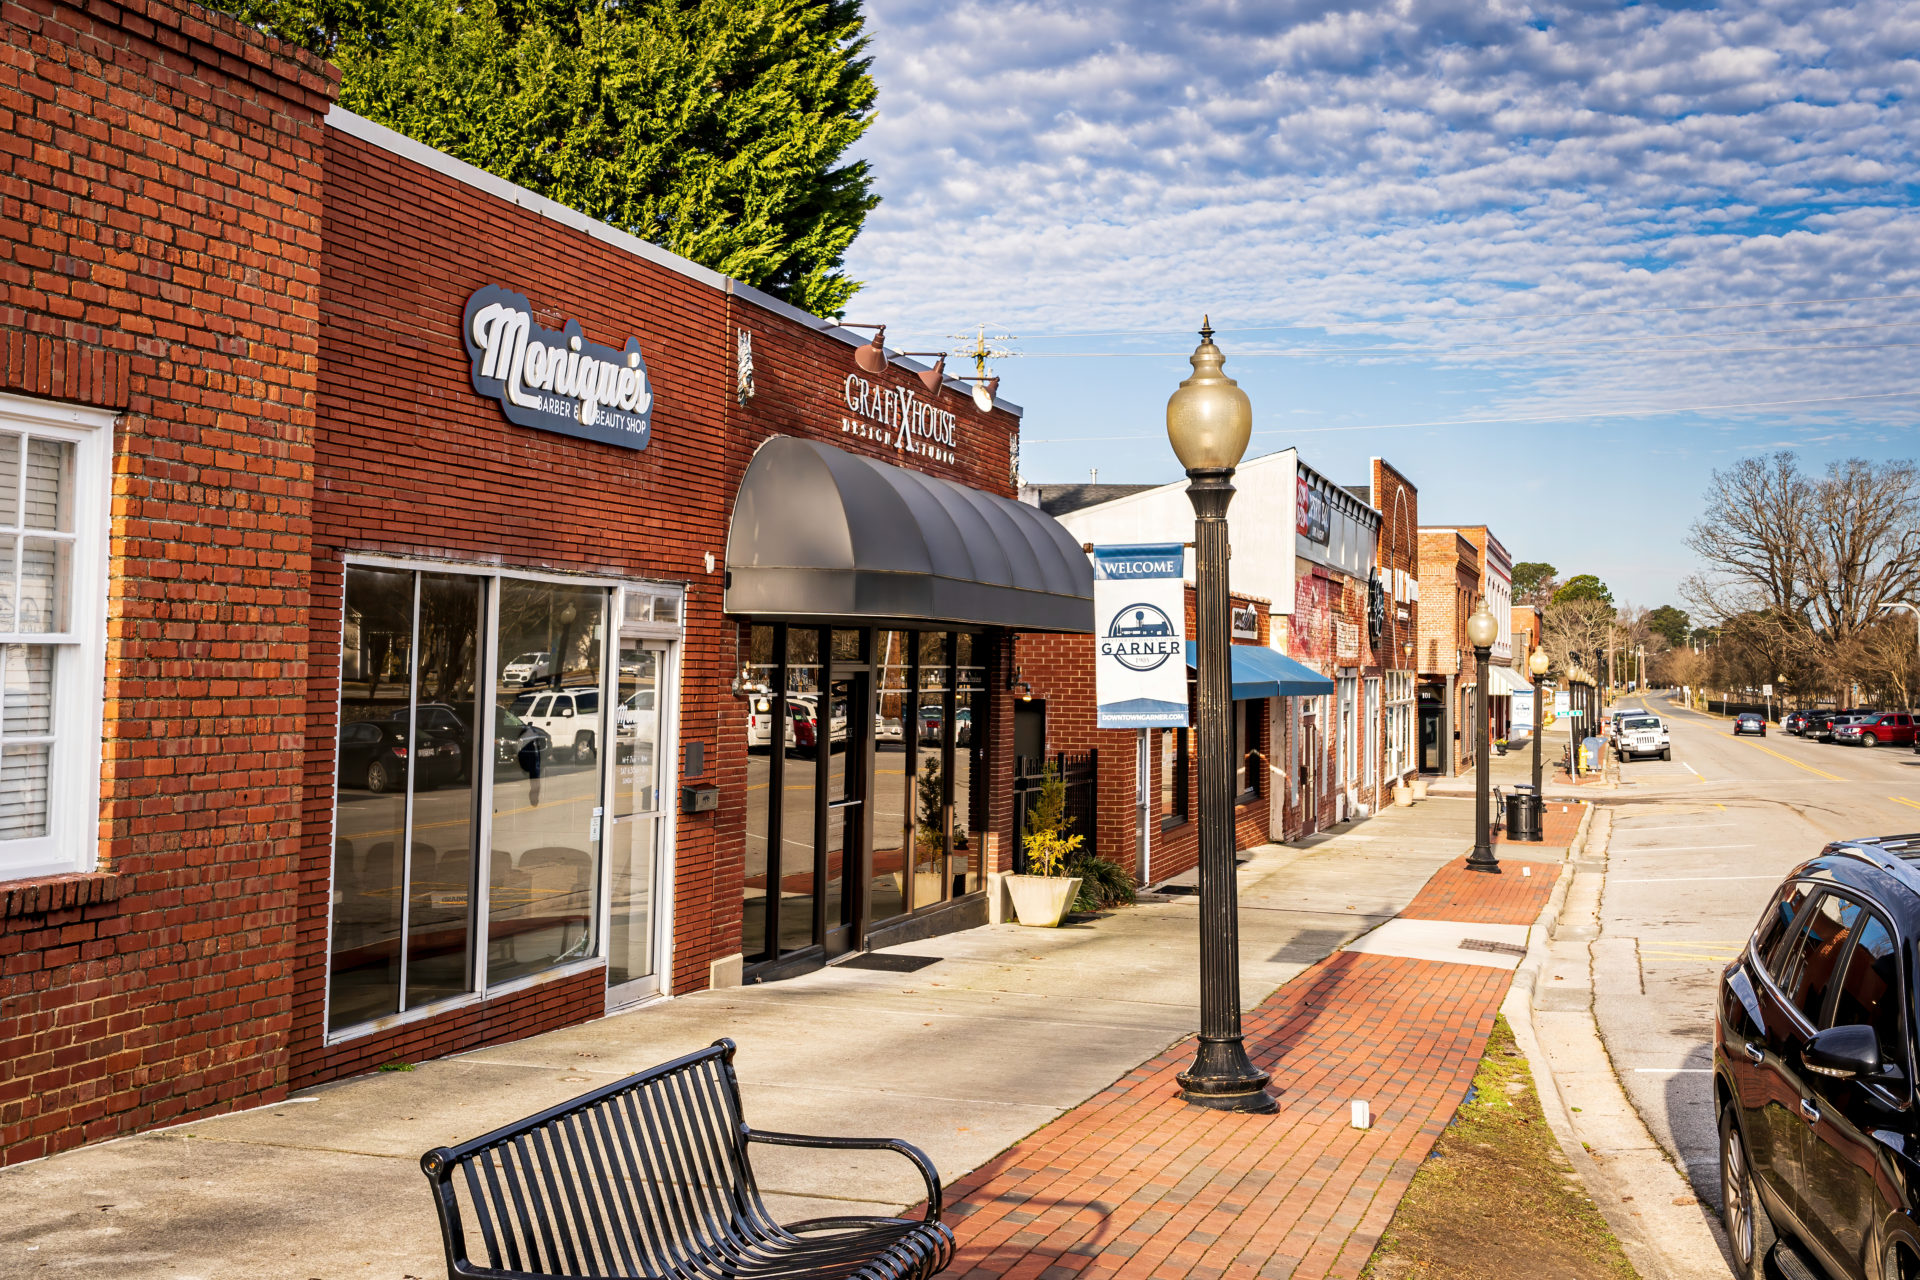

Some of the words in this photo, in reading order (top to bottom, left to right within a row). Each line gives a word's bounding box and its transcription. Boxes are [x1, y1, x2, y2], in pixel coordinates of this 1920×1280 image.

[473, 303, 651, 425] Monique's
[538, 395, 570, 418] BARBER
[596, 410, 625, 430] BEAUTY
[626, 417, 647, 435] SHOP
[841, 418, 892, 445] DESIGN
[914, 441, 955, 465] STUDIO
[1104, 560, 1174, 575] WELCOME
[1101, 641, 1180, 655] GARNER
[1102, 713, 1184, 721] DOWNTOWNGARNER.COM
